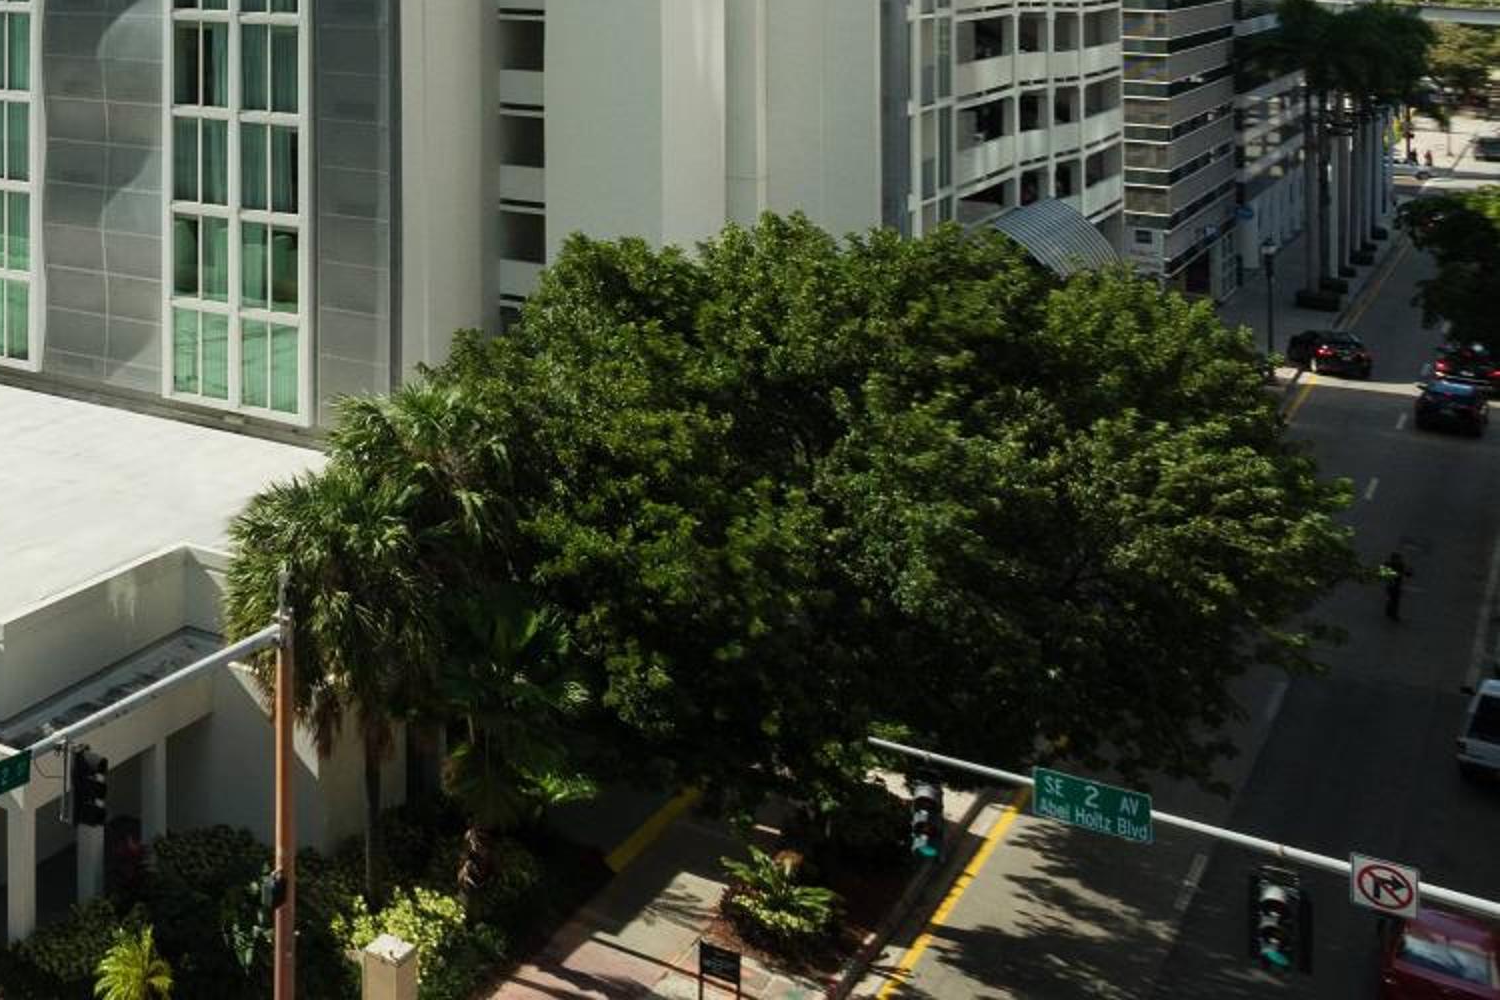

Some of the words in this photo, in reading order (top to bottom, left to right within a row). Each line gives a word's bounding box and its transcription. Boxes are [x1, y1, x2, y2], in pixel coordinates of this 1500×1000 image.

[1043, 775, 1064, 798] SE
[1083, 785, 1100, 809] 2
[1120, 796, 1140, 817] AV
[1075, 808, 1112, 834] Holtz
[1117, 817, 1148, 840] Blvd
